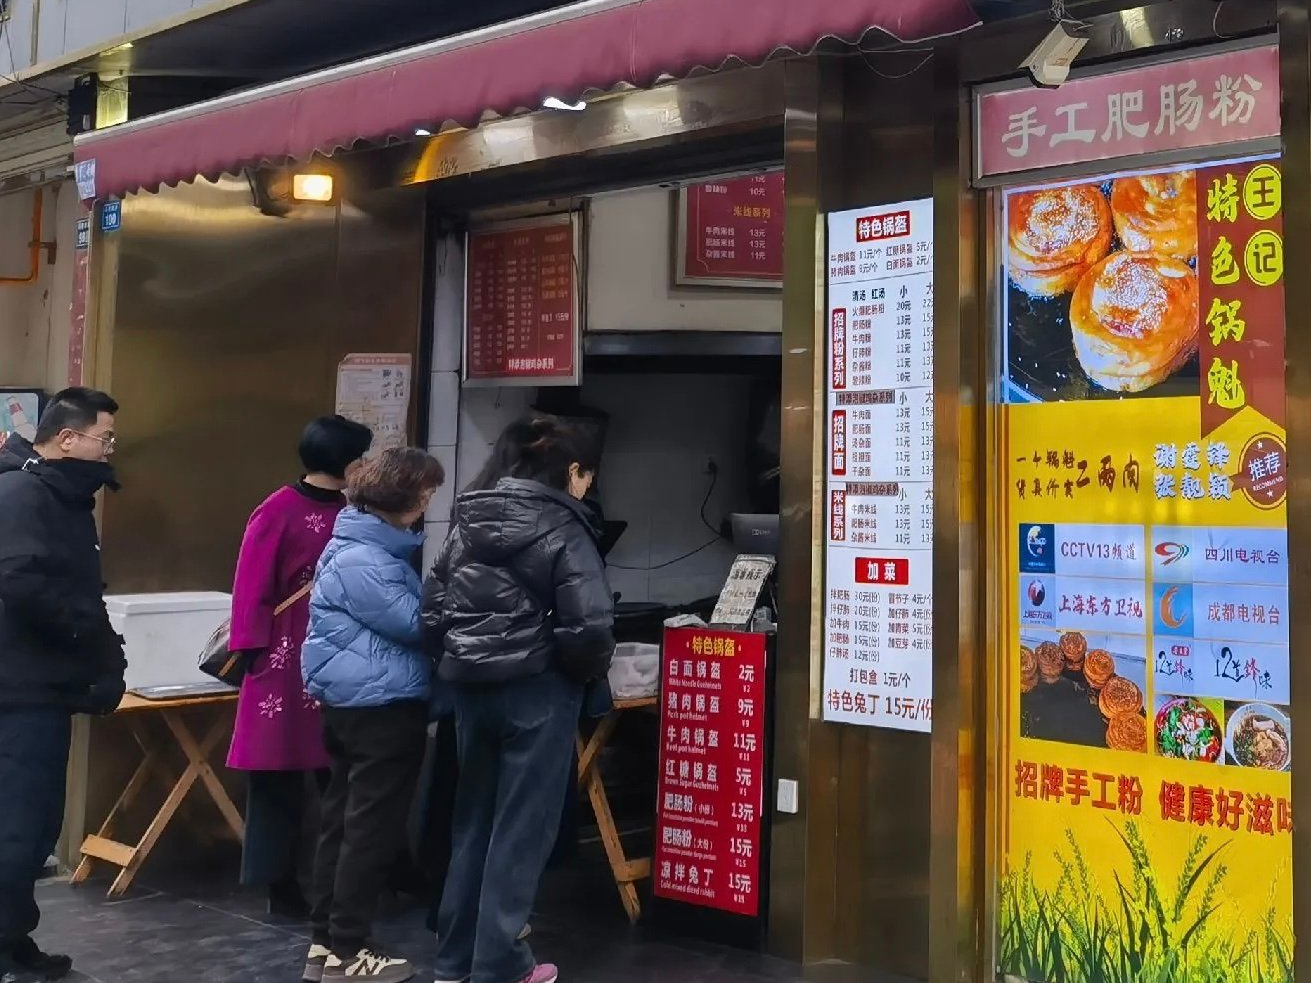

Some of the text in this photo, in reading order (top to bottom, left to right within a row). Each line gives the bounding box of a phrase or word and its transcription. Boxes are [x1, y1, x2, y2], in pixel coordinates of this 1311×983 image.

[1002, 73, 1263, 158] 手工肥肠粉
[859, 215, 908, 239] 特色锅盔
[1250, 174, 1280, 275] 王记
[900, 284, 907, 299] 小
[1206, 173, 1246, 410] 特色锅魁
[900, 392, 907, 405] 小
[1248, 450, 1282, 482] 推荐
[1060, 541, 1137, 560] CCTV13频道
[1204, 547, 1281, 564] 四川电视台
[867, 561, 896, 580] 加菜
[1058, 594, 1143, 618] 上海东方卫视
[1207, 603, 1281, 625] 成都电视台
[692, 636, 735, 657] 特色锅盔
[669, 659, 755, 682] 白面锅盔 2元
[668, 691, 754, 716] 猪肉锅盔 9元
[827, 689, 880, 715] 特色兔丁
[667, 725, 756, 752] 牛肉锅盔 11元
[665, 759, 717, 782] 红糖锅盔
[736, 767, 752, 786] 5元
[1014, 759, 1144, 815] 招牌手工粉
[731, 802, 754, 822] 13元
[730, 837, 753, 857] 15元
[661, 861, 752, 894] 凉拌兔丁 15元
